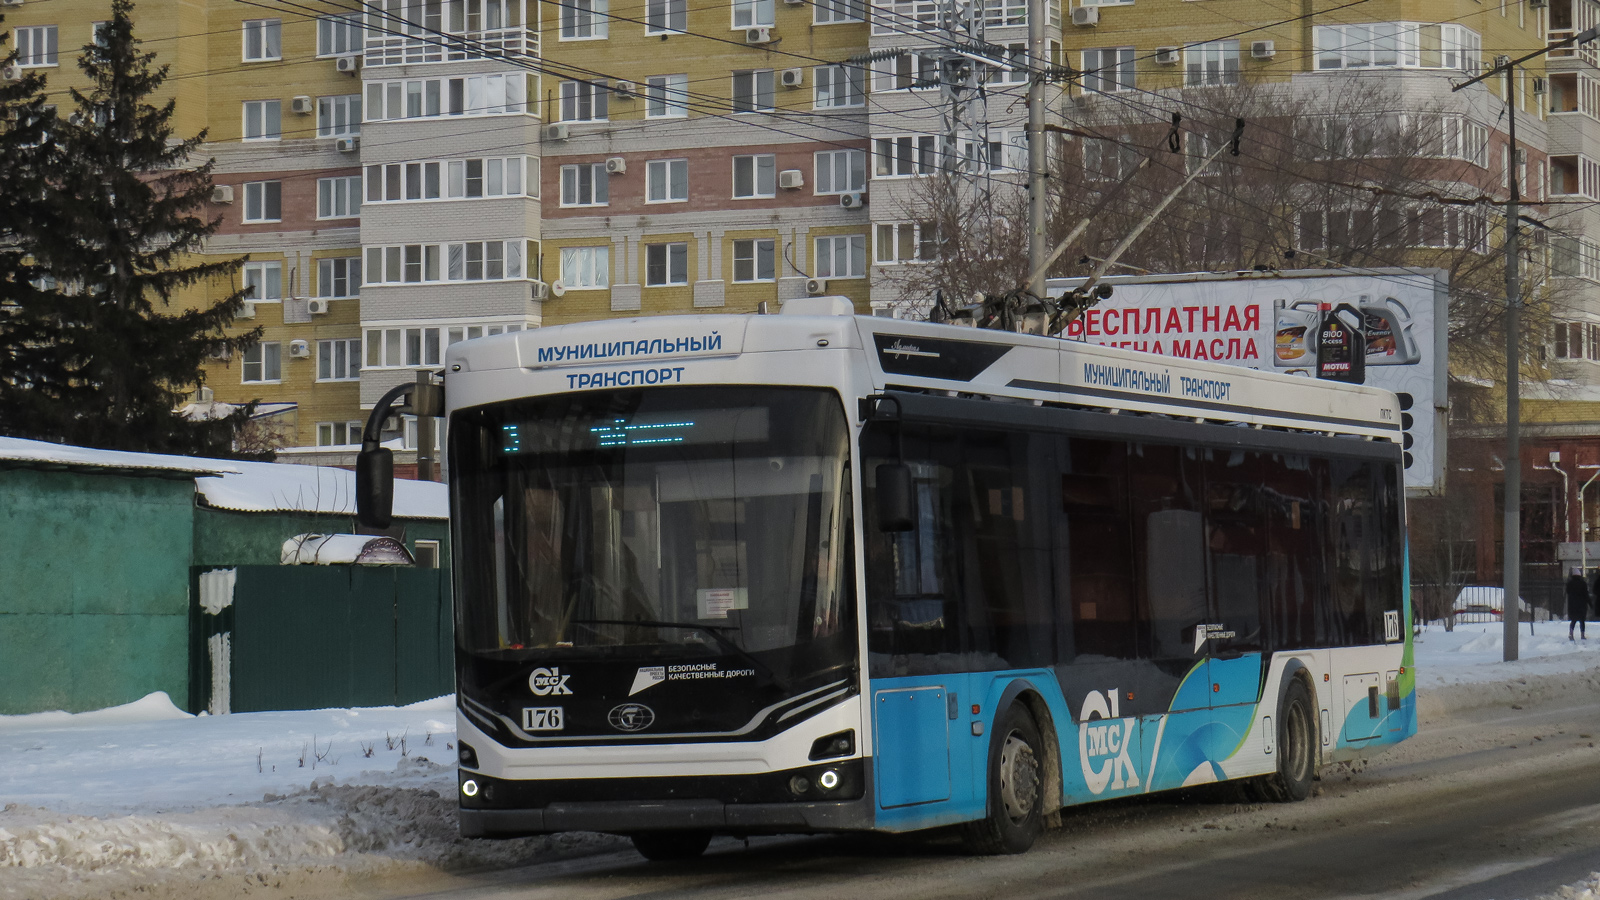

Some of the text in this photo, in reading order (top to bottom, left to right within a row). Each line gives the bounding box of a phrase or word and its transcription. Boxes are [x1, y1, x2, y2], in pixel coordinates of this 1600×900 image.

[1068, 304, 1260, 336] БЕСПЛАТНАЯ
[1322, 330, 1343, 338] 8100
[537, 331, 722, 363] МУНИЦИПАЛЬНЫЙ
[1172, 338, 1259, 360] МАСЛА
[566, 367, 685, 389] ТРАНСПОРТ
[1084, 362, 1231, 401] МУНИЦИПАЛЬНЫЙ ТРАНСПОРТ
[1385, 613, 1398, 638] 176
[668, 663, 717, 673] БЕЗОПАСНЫЕ
[668, 669, 755, 680] КАЧЕСТВЕННЫЕ ДОРОГИ
[525, 709, 560, 728] 176
